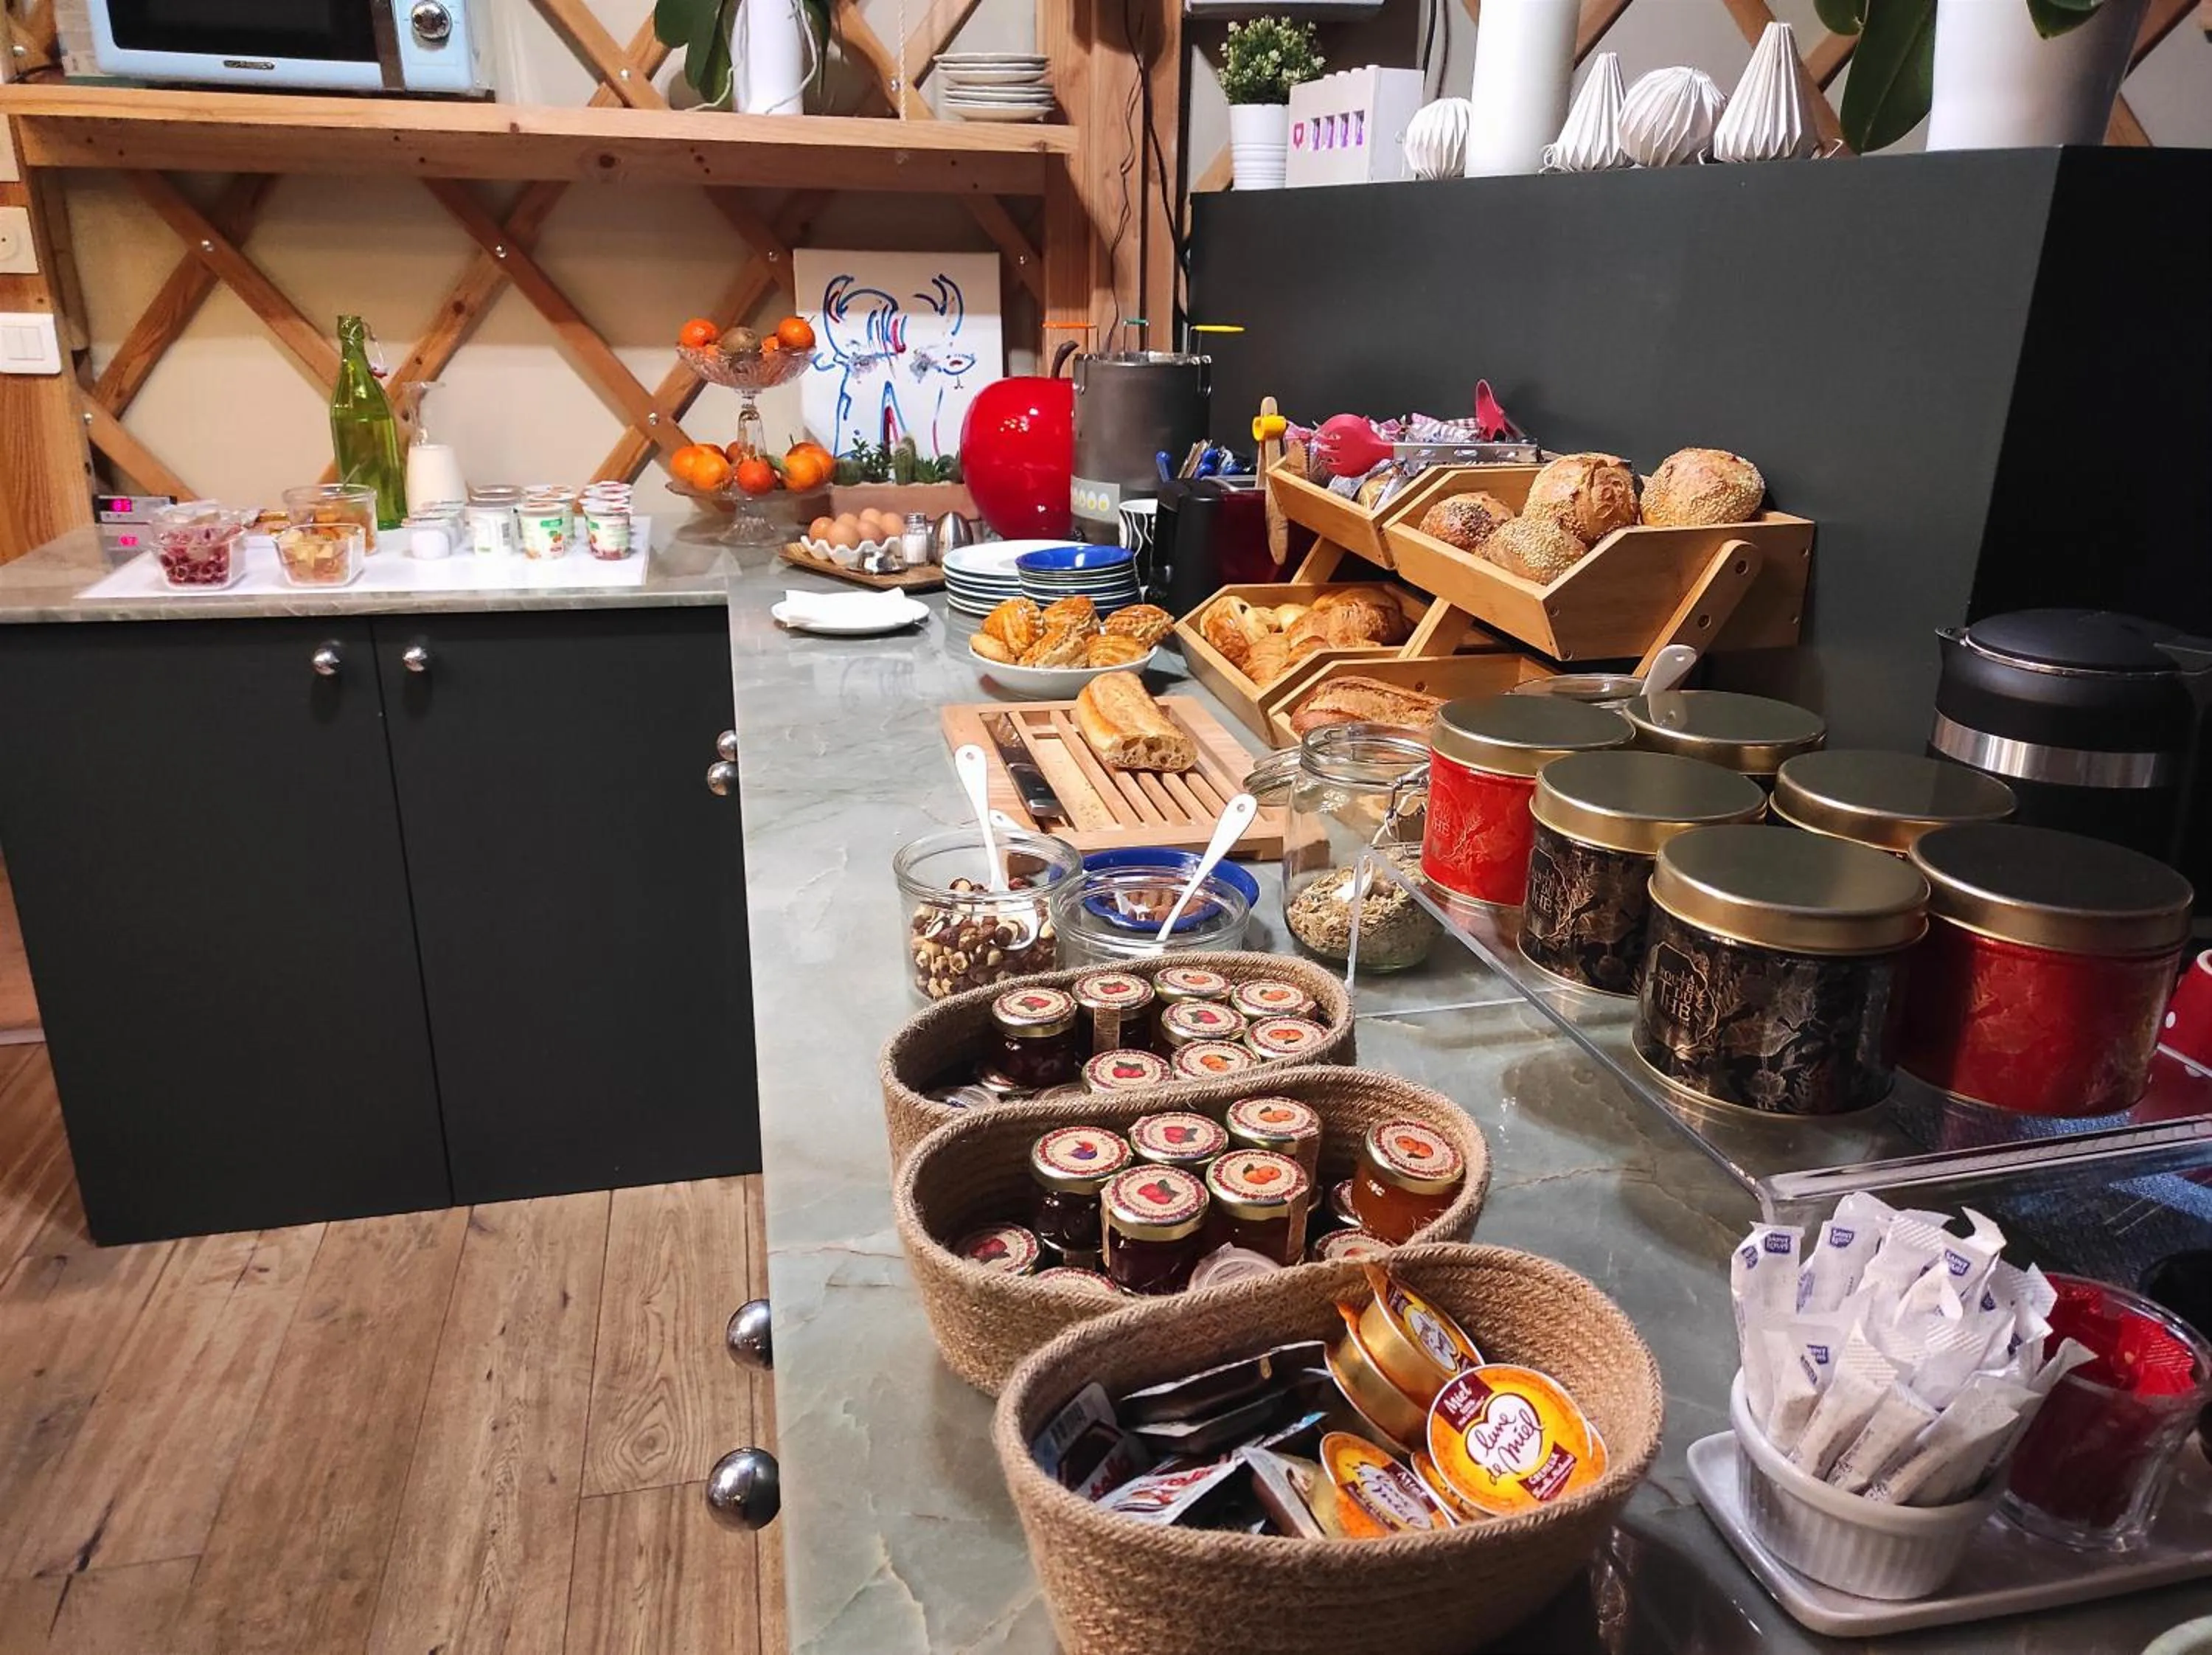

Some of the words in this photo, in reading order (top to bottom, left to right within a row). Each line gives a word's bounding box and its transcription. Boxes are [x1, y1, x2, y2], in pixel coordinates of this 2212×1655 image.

[1443, 1380, 1472, 1415] Miel
[1475, 1412, 1516, 1457] lune
[1486, 1463, 1508, 1486] de
